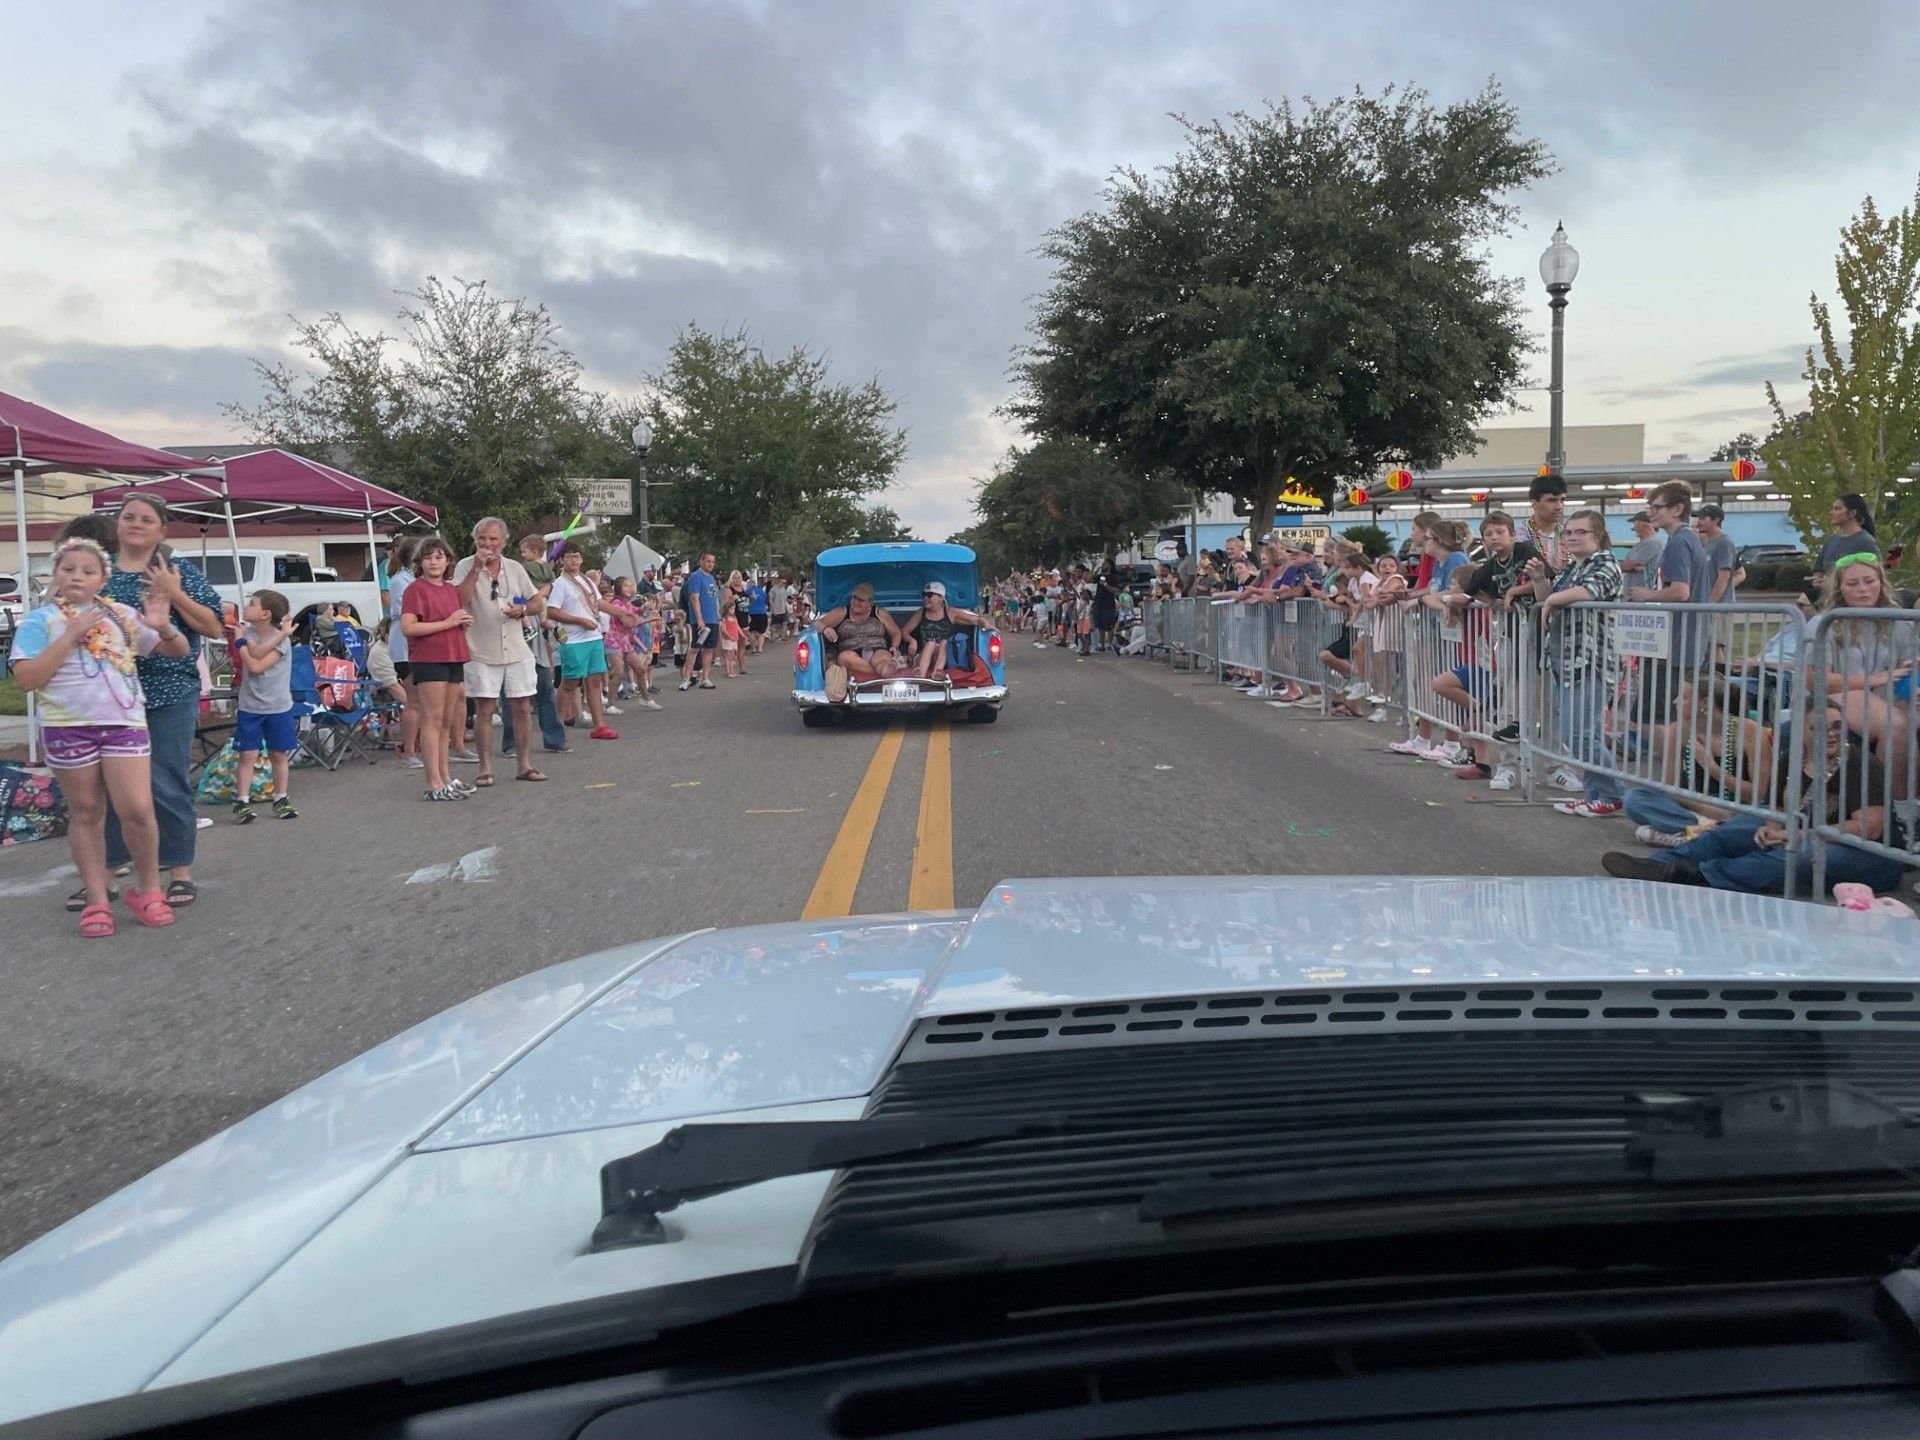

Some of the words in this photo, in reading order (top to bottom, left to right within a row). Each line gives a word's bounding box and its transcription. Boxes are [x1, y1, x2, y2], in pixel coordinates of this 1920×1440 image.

[593, 501, 628, 509] 865-9652
[1281, 529, 1297, 538] NEW
[1299, 529, 1325, 538] SALTED
[1617, 614, 1633, 627] LONG
[1634, 615, 1655, 628] BEACH
[1656, 616, 1665, 629] PD
